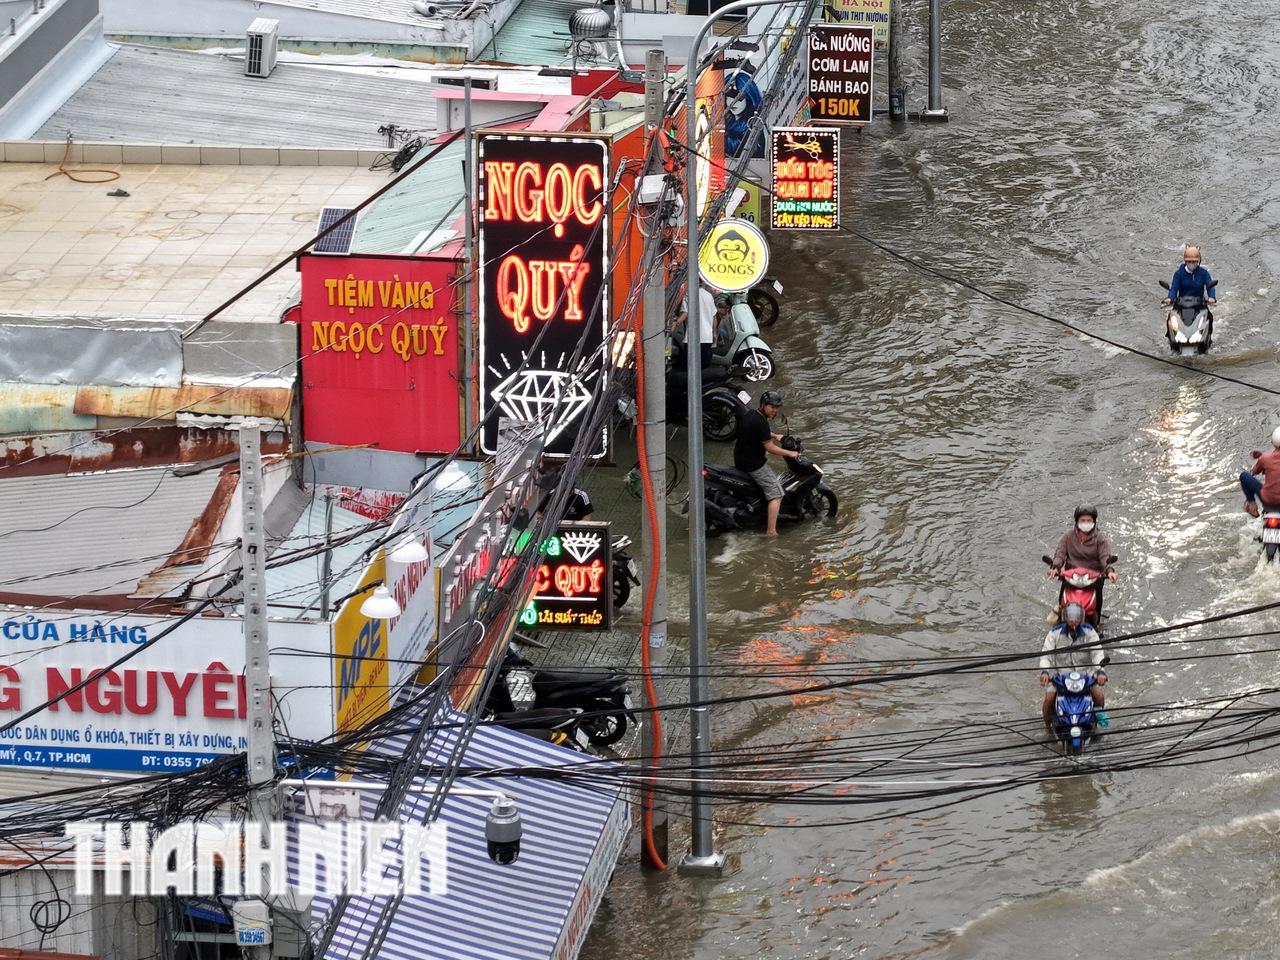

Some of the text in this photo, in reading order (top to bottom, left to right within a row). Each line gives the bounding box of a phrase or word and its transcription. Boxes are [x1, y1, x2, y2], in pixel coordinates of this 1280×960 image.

[830, 32, 871, 53] NƯỚNG
[811, 58, 869, 74] CƠM LAM
[810, 77, 869, 95] BÁNH BAO
[818, 97, 861, 117] 150K
[807, 158, 834, 180] TÓC
[484, 161, 602, 238] NGỌC
[325, 273, 434, 314] TIỆM VÀNG
[496, 243, 591, 334] QUÝ
[311, 317, 449, 362] NGỌC QUÝ
[554, 559, 604, 597] QUÝ
[3, 614, 148, 645] CỬA HÀNG
[25, 725, 47, 741] DÂN
[50, 728, 80, 745] DỤNG
[129, 728, 161, 746] THIẾT
[165, 733, 176, 750] BỊ
[178, 730, 200, 748] XÂY
[48, 751, 92, 764] TP.HCM
[142, 755, 161, 768] ĐT:
[163, 756, 193, 768] 0355
